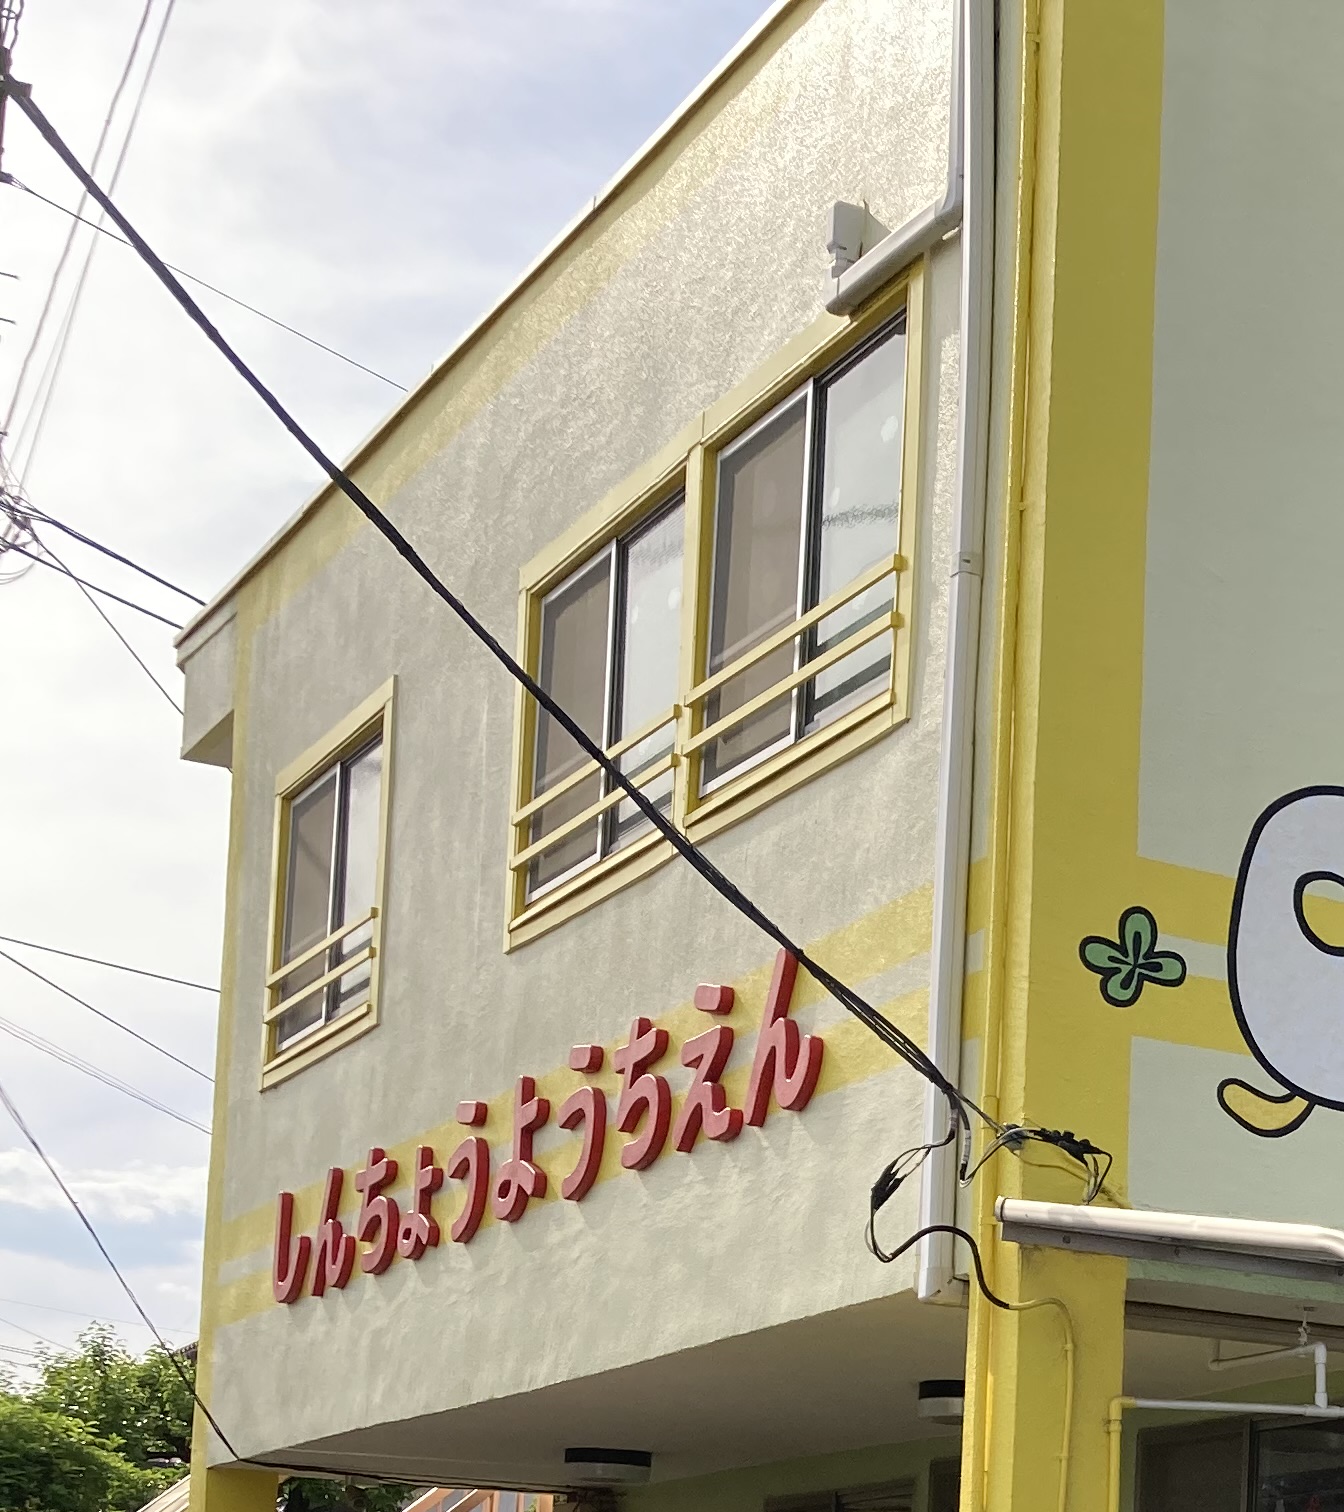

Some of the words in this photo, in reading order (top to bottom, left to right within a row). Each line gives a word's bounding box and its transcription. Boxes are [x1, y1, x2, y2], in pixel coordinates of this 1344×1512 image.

[273, 948, 823, 1304] しんちょうようちえん
